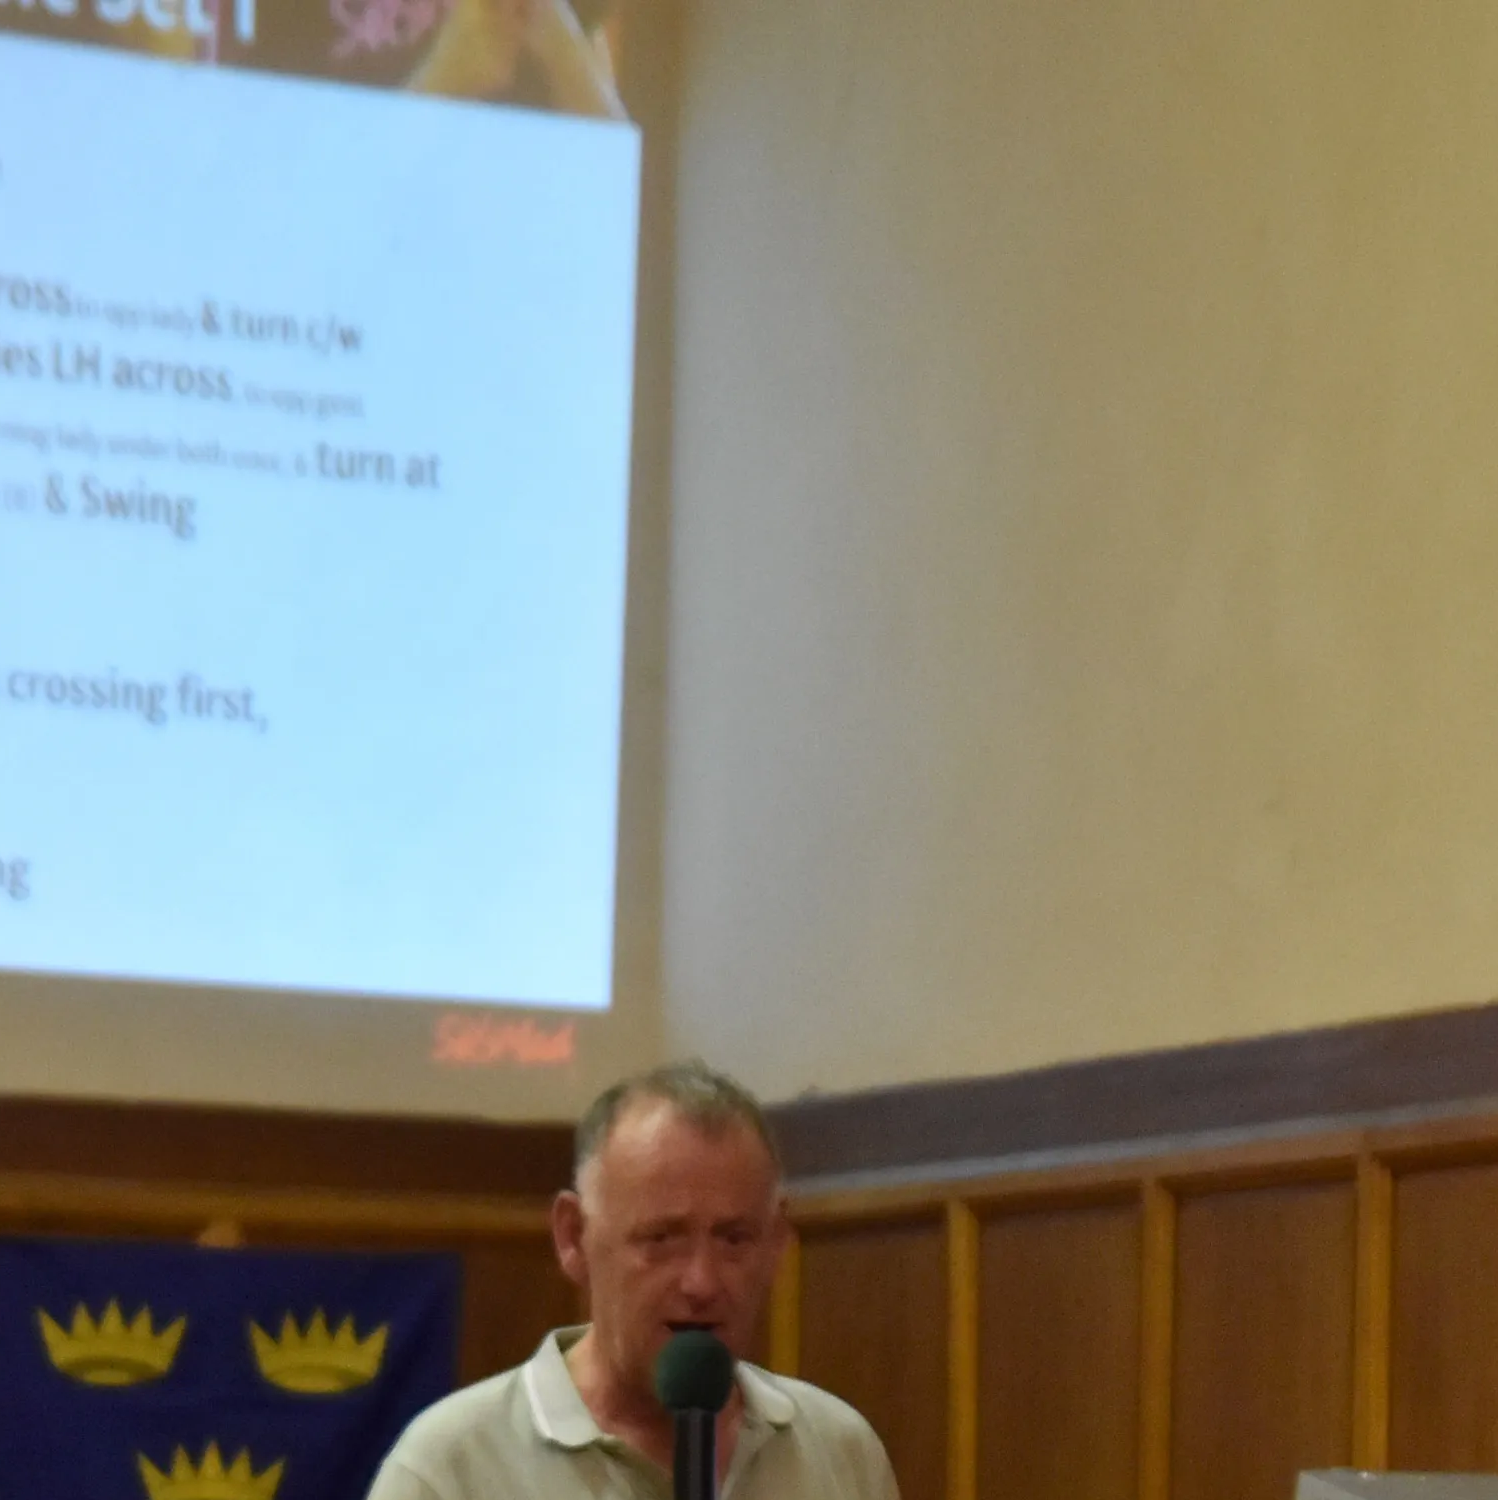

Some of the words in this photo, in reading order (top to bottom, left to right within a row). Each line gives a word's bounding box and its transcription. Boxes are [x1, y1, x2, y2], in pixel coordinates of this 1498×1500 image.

[199, 298, 222, 337] &
[231, 303, 299, 343] turn
[306, 312, 363, 357] c/w
[52, 337, 101, 386] LH
[113, 355, 235, 402] across
[316, 440, 395, 482] turn
[405, 451, 442, 491] at
[44, 470, 69, 514] &
[79, 473, 197, 540] Swing
[8, 664, 167, 727] crossing
[177, 670, 268, 734] first,
